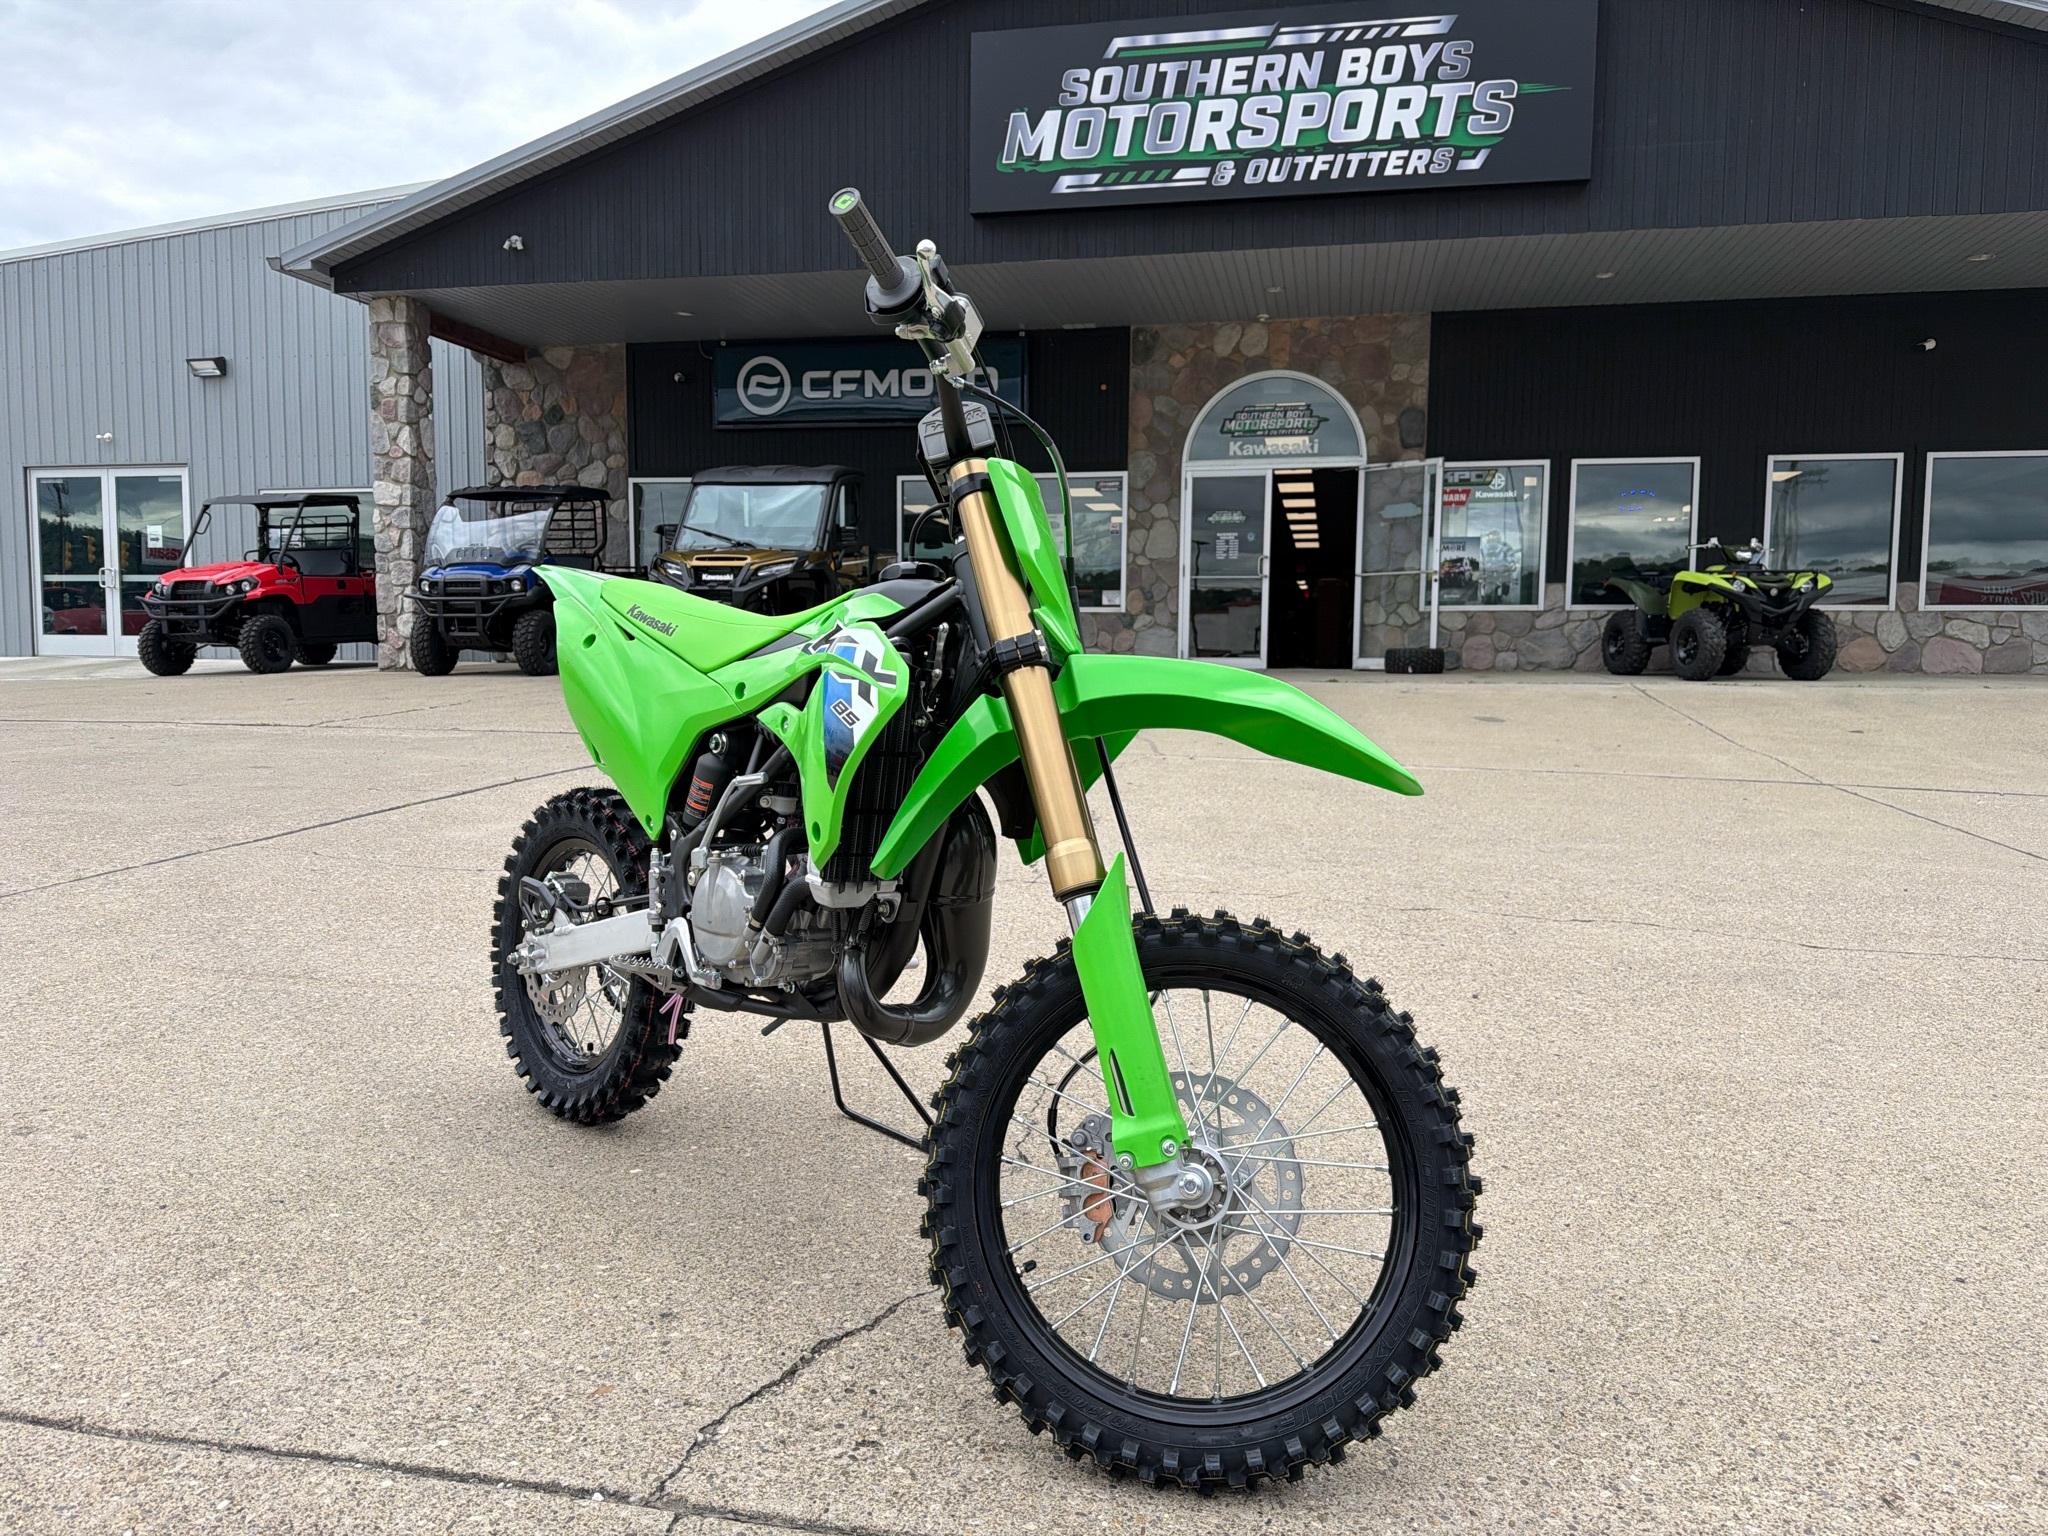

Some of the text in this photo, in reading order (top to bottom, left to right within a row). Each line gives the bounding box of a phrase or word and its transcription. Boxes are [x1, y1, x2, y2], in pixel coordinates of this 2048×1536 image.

[1058, 40, 1474, 107] SOUTHERN BOYS
[1001, 79, 1518, 165] MOTORSPORTS
[1211, 147, 1455, 187] & OUTFITTERS
[802, 366, 999, 399] CFMOO
[1223, 417, 1319, 432] MOTORSPORTS
[1236, 410, 1285, 421] SOUTHERN
[1228, 438, 1320, 456] Kawasaki
[1475, 490, 1517, 499] Kawasaki
[702, 573, 734, 581] Kawasaki
[626, 603, 679, 638] Kawasaki
[831, 700, 861, 729] 85
